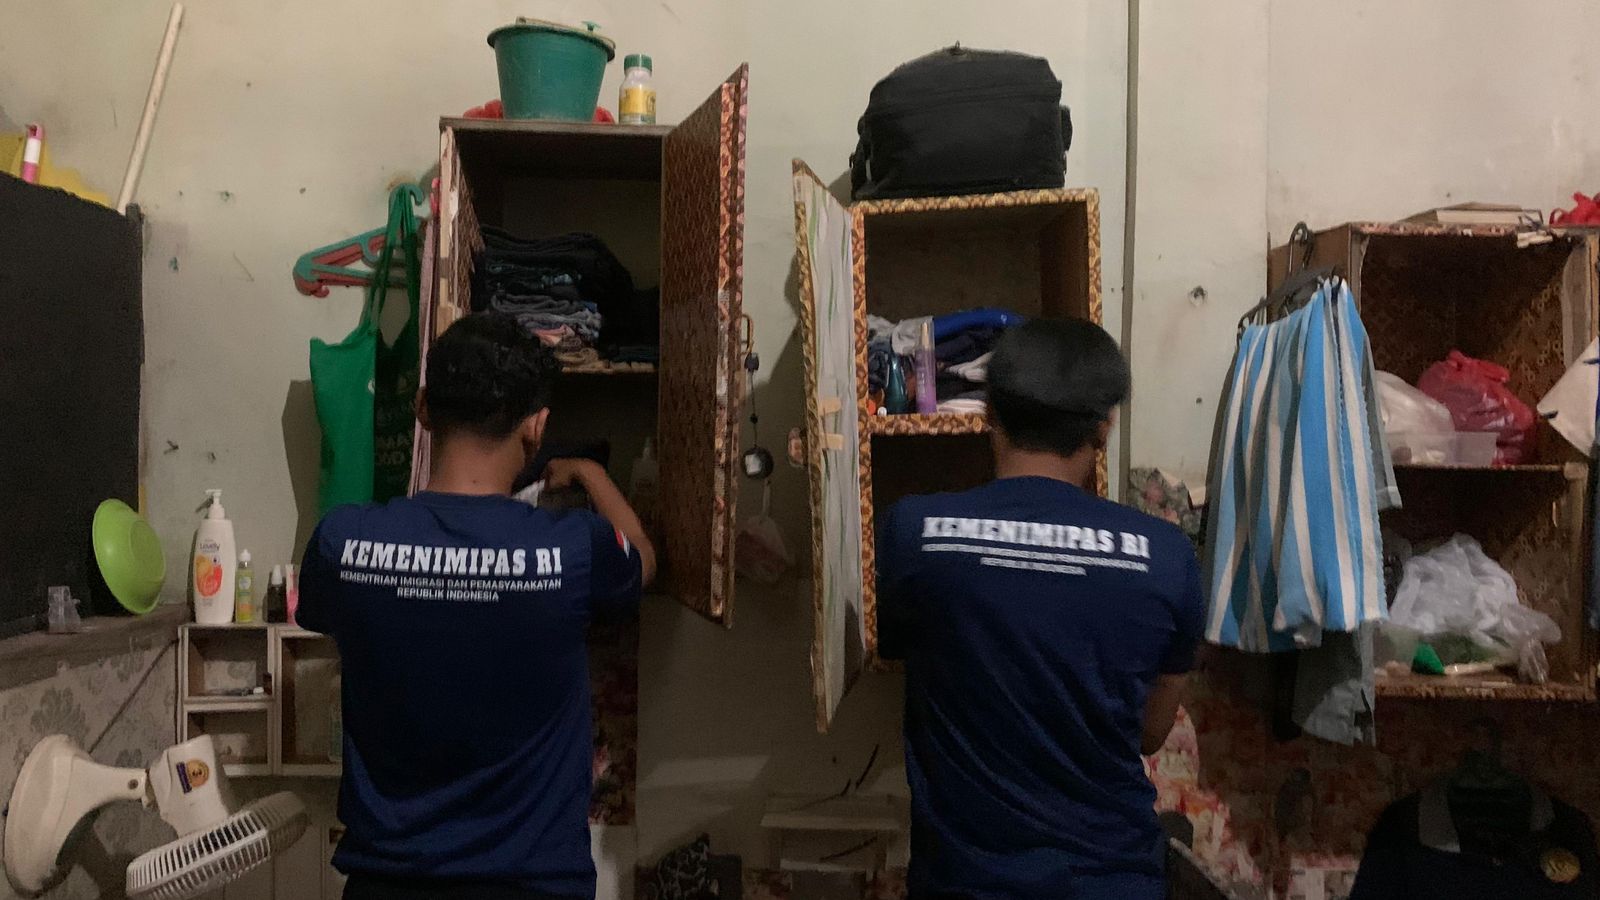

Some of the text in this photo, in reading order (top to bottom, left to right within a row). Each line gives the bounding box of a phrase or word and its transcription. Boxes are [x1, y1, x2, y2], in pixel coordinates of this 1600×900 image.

[340, 539, 562, 576] KEMENIMIPAS RI
[340, 570, 562, 592] KEMENTRIAN IMIGRASI DAN PEMASYARAKATAN
[397, 587, 499, 602] REPUBLIK INDONESIA
